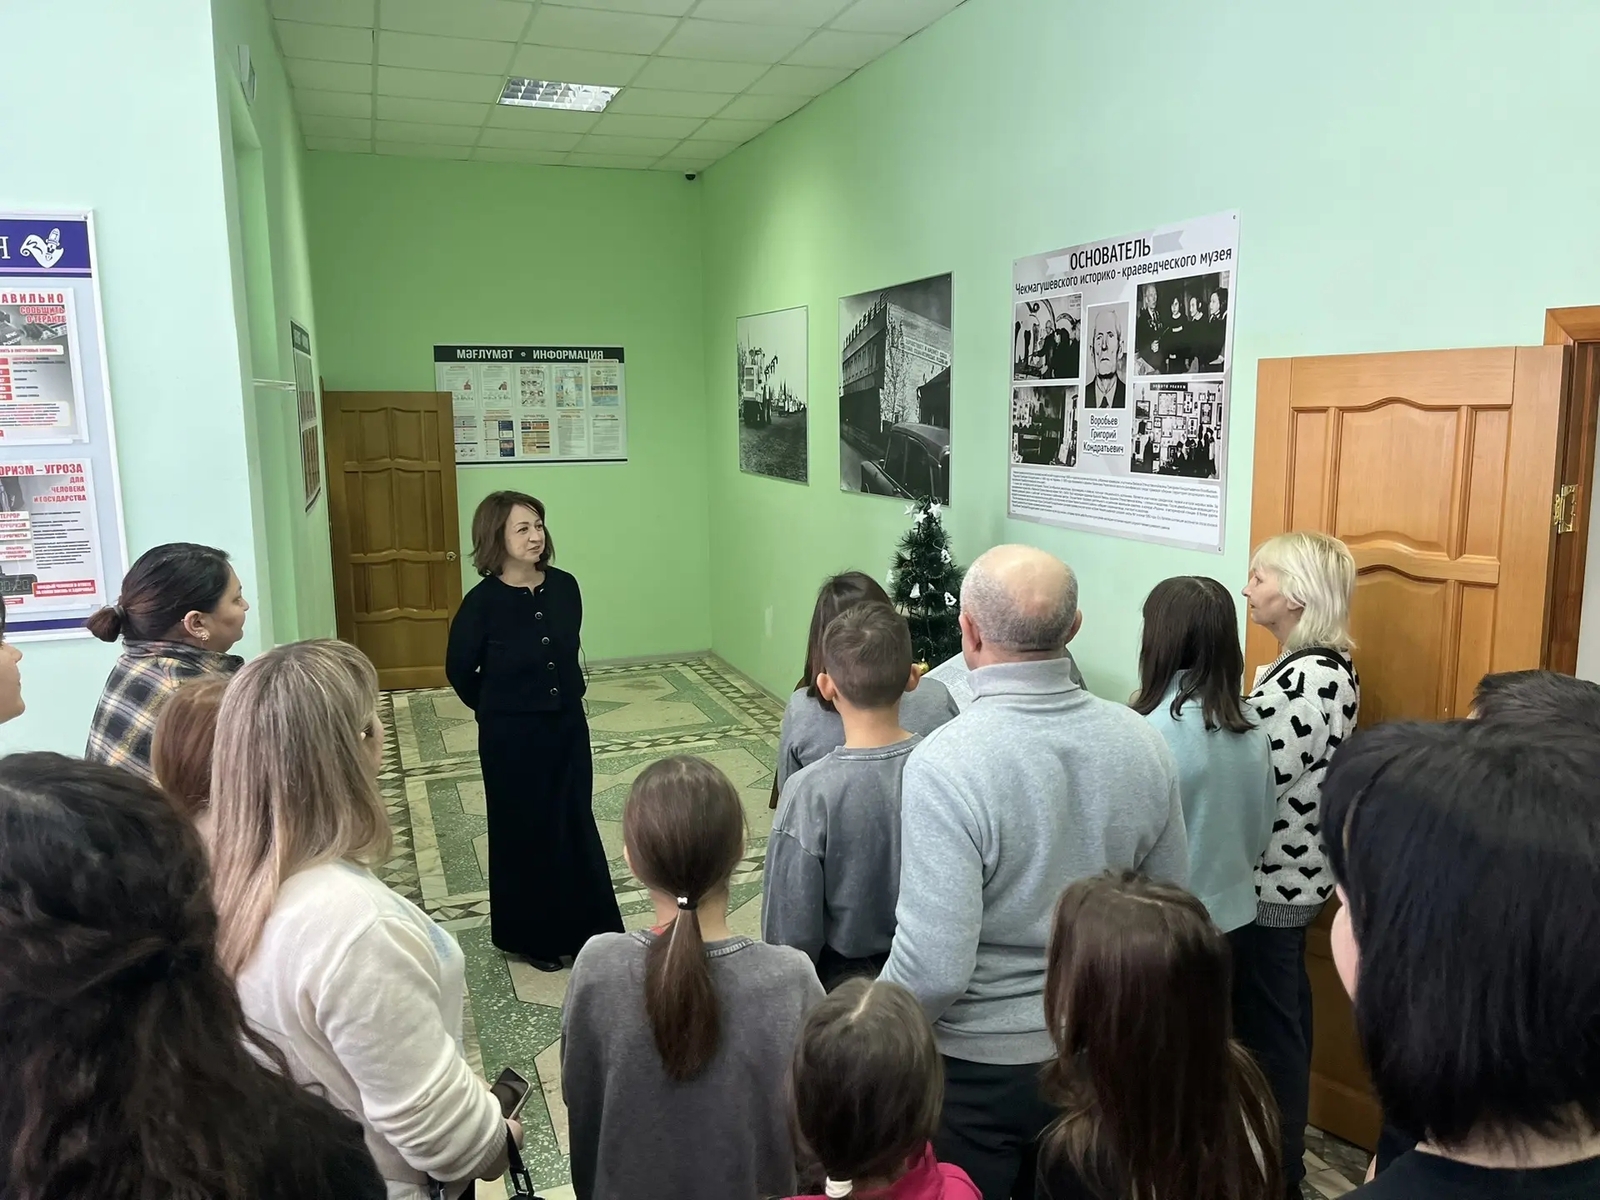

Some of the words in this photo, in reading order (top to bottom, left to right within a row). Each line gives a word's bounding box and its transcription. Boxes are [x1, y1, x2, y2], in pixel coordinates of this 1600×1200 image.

[1070, 238, 1151, 270] ОСНОВАТЕЛЬ
[1015, 276, 1078, 295] Чекмагушевского
[1080, 270, 1116, 285] историко
[1122, 254, 1197, 280] краеведческого
[1200, 248, 1232, 267] музея
[533, 349, 604, 360] ИНФОРМАЦИЯ
[1090, 414, 1119, 427] Воробьев
[1090, 428, 1117, 441] Григорий
[1083, 441, 1124, 454] Кондратьевич
[44, 463, 83, 474] УГРОЗА
